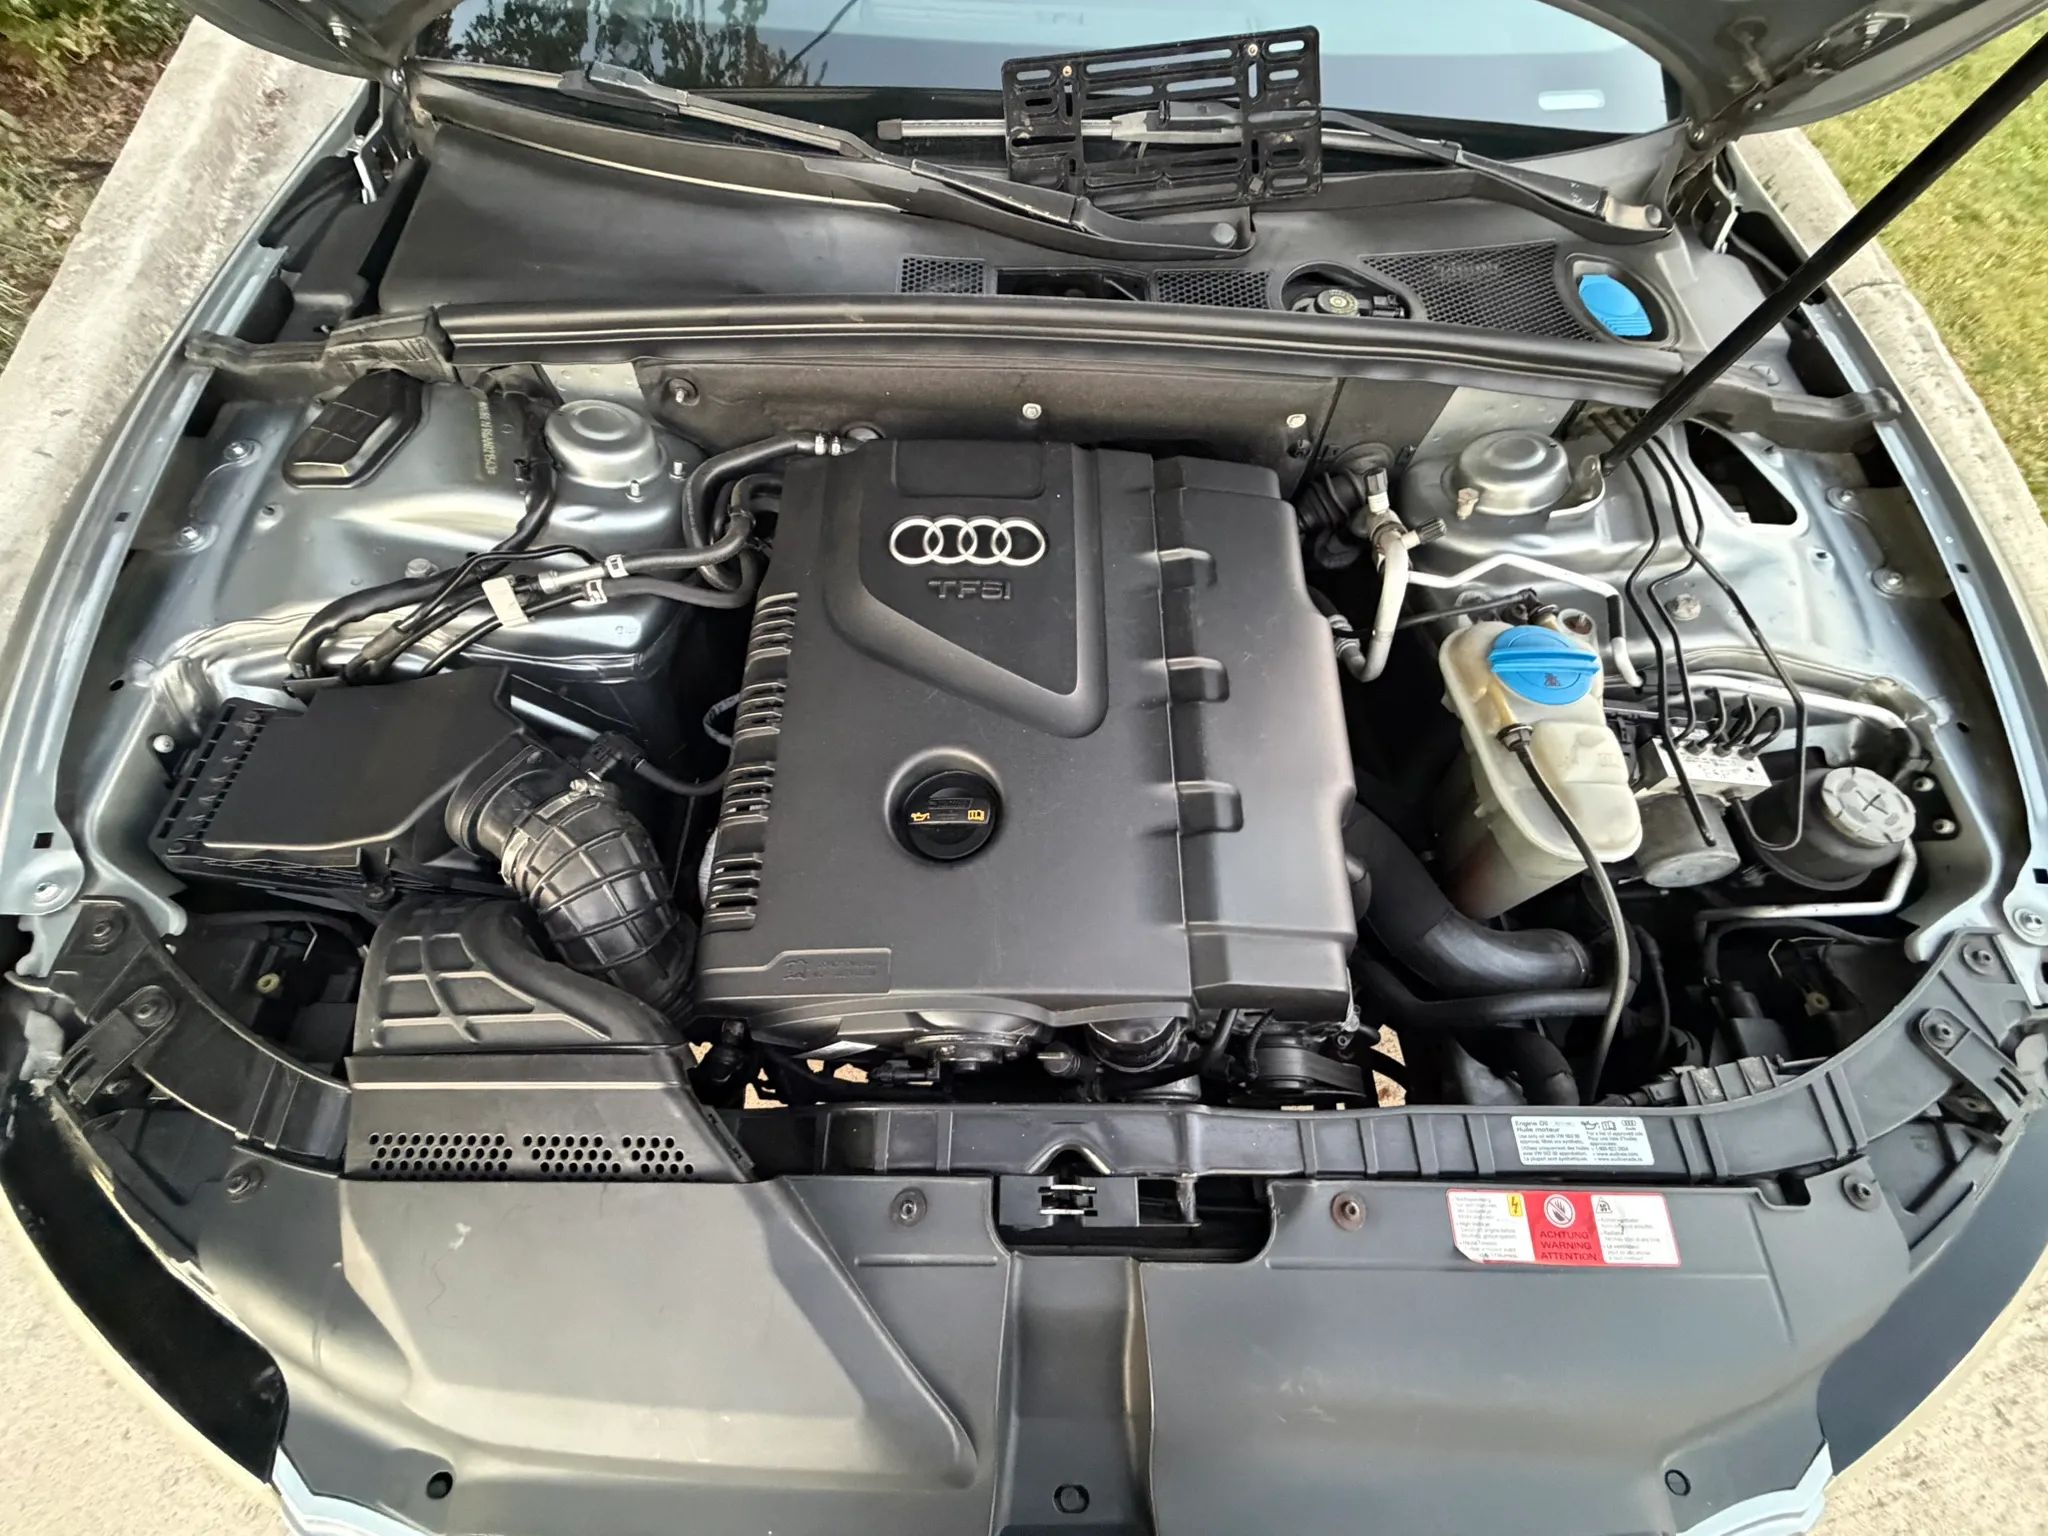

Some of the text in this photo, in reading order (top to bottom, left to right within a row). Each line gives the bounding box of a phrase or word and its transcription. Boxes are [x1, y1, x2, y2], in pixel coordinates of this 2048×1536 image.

[928, 579, 1011, 600] TFSI
[1540, 1230, 1589, 1239] ACHTUNG
[1541, 1241, 1592, 1250] WARNING
[1541, 1252, 1597, 1261] ATTENTION
